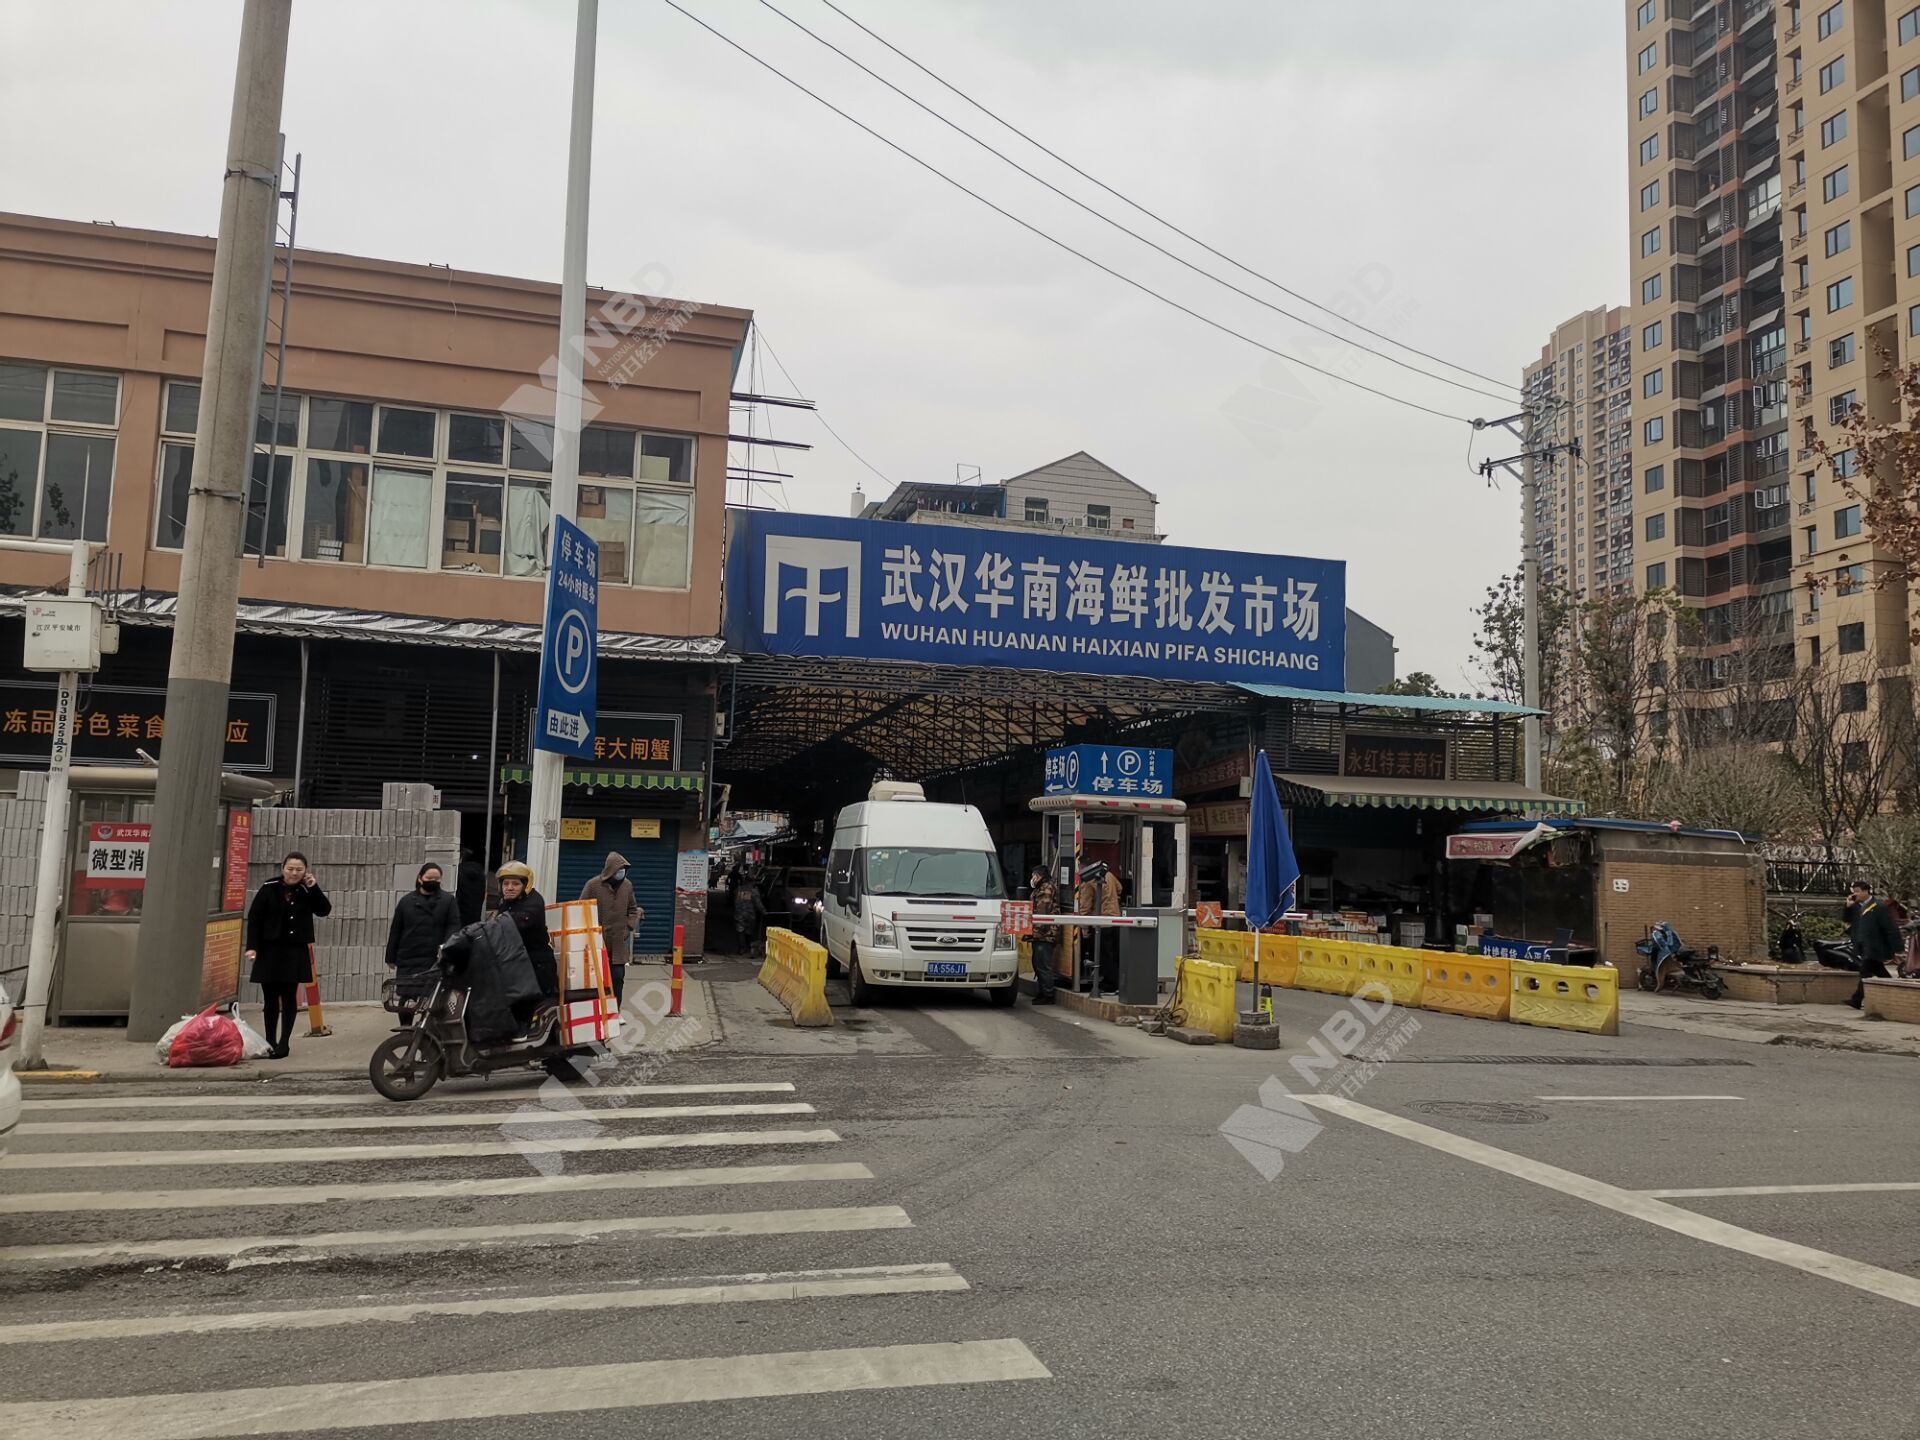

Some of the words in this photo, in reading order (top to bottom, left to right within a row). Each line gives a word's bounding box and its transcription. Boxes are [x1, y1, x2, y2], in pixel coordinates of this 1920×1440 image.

[561, 530, 595, 578] 停车场
[881, 544, 1320, 643] 武汉华南海鲜批发市场
[881, 622, 967, 647] WUHAN
[972, 630, 1067, 653] HUANAN
[1072, 637, 1160, 660] HAIXIAN
[1165, 643, 1209, 662] PIFA
[1214, 647, 1320, 672] SHICHANG
[550, 713, 579, 738] 由此进
[1092, 776, 1163, 794] 停车场
